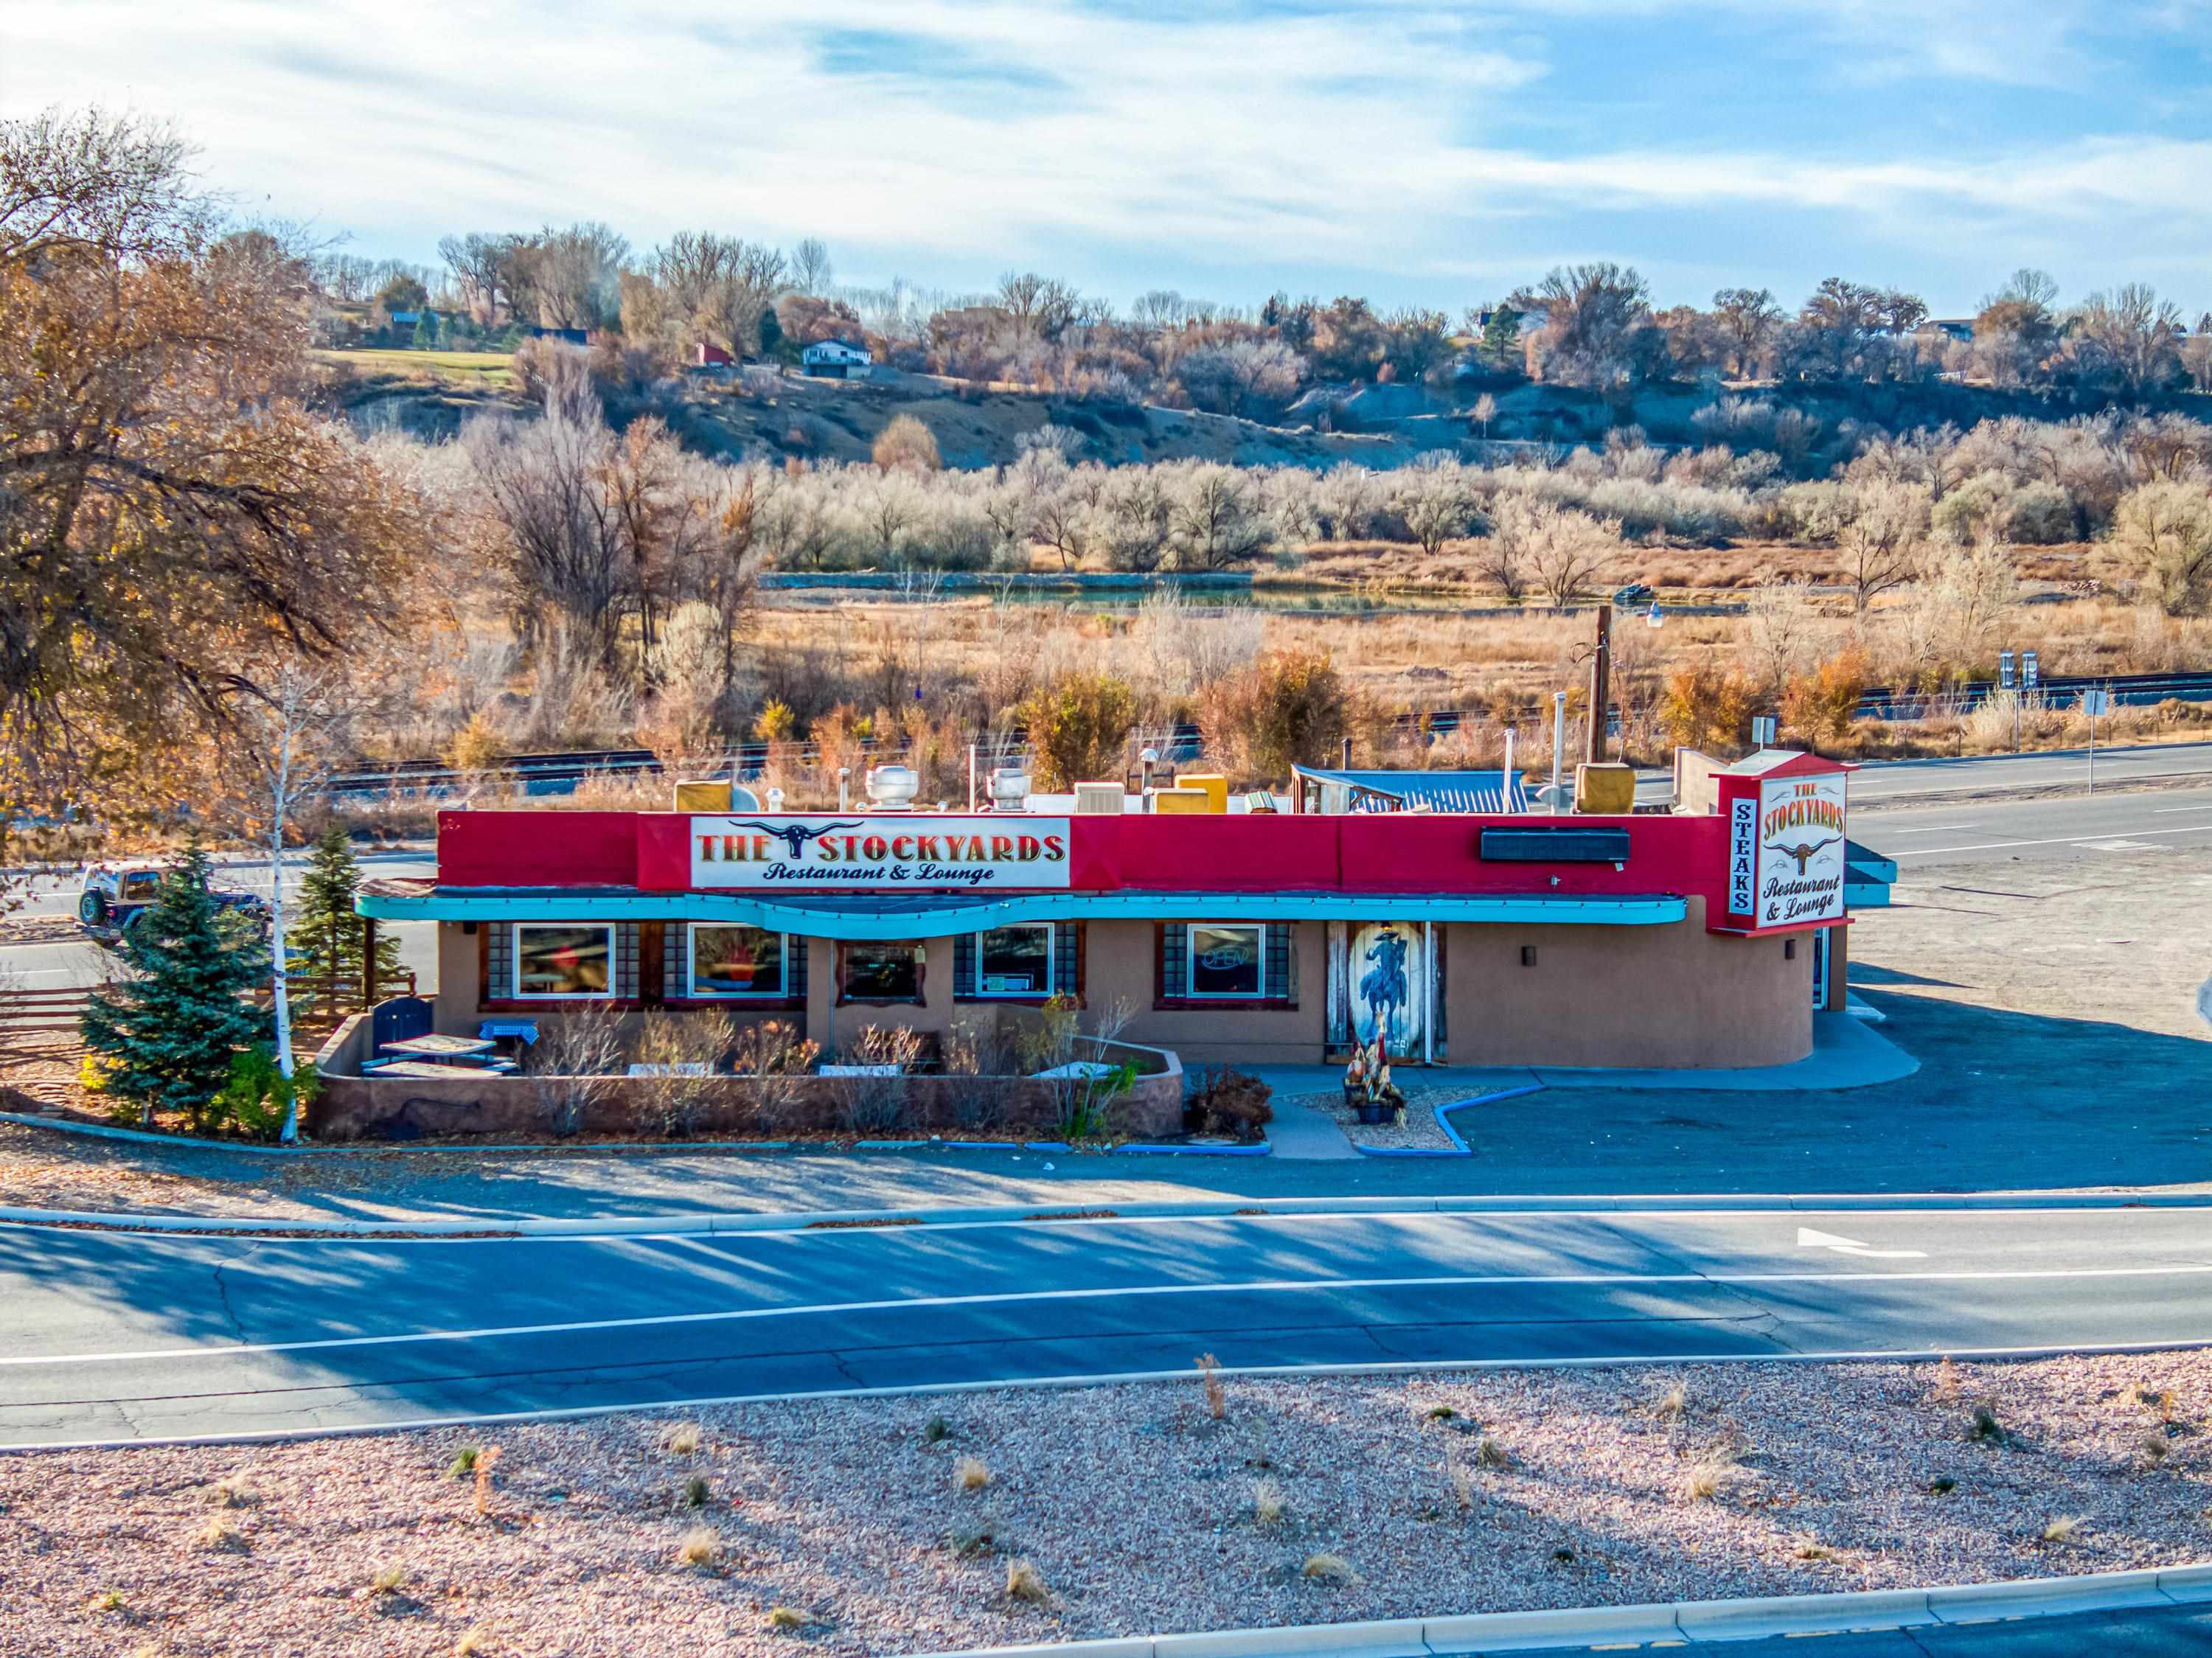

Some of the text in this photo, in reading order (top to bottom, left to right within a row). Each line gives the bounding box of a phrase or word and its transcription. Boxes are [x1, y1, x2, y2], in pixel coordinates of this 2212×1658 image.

[1794, 783, 1817, 796] THE
[1764, 799, 1843, 840] STOCKYARDS
[696, 835, 1066, 862] THE STOCKYARDS
[1733, 804, 1752, 909] STEAKS
[762, 862, 995, 885] Restaurant & Lounge
[1763, 874, 1840, 899] Restaurant
[1767, 893, 1834, 921] & Lounge
[1203, 949, 1246, 965] OPEN
